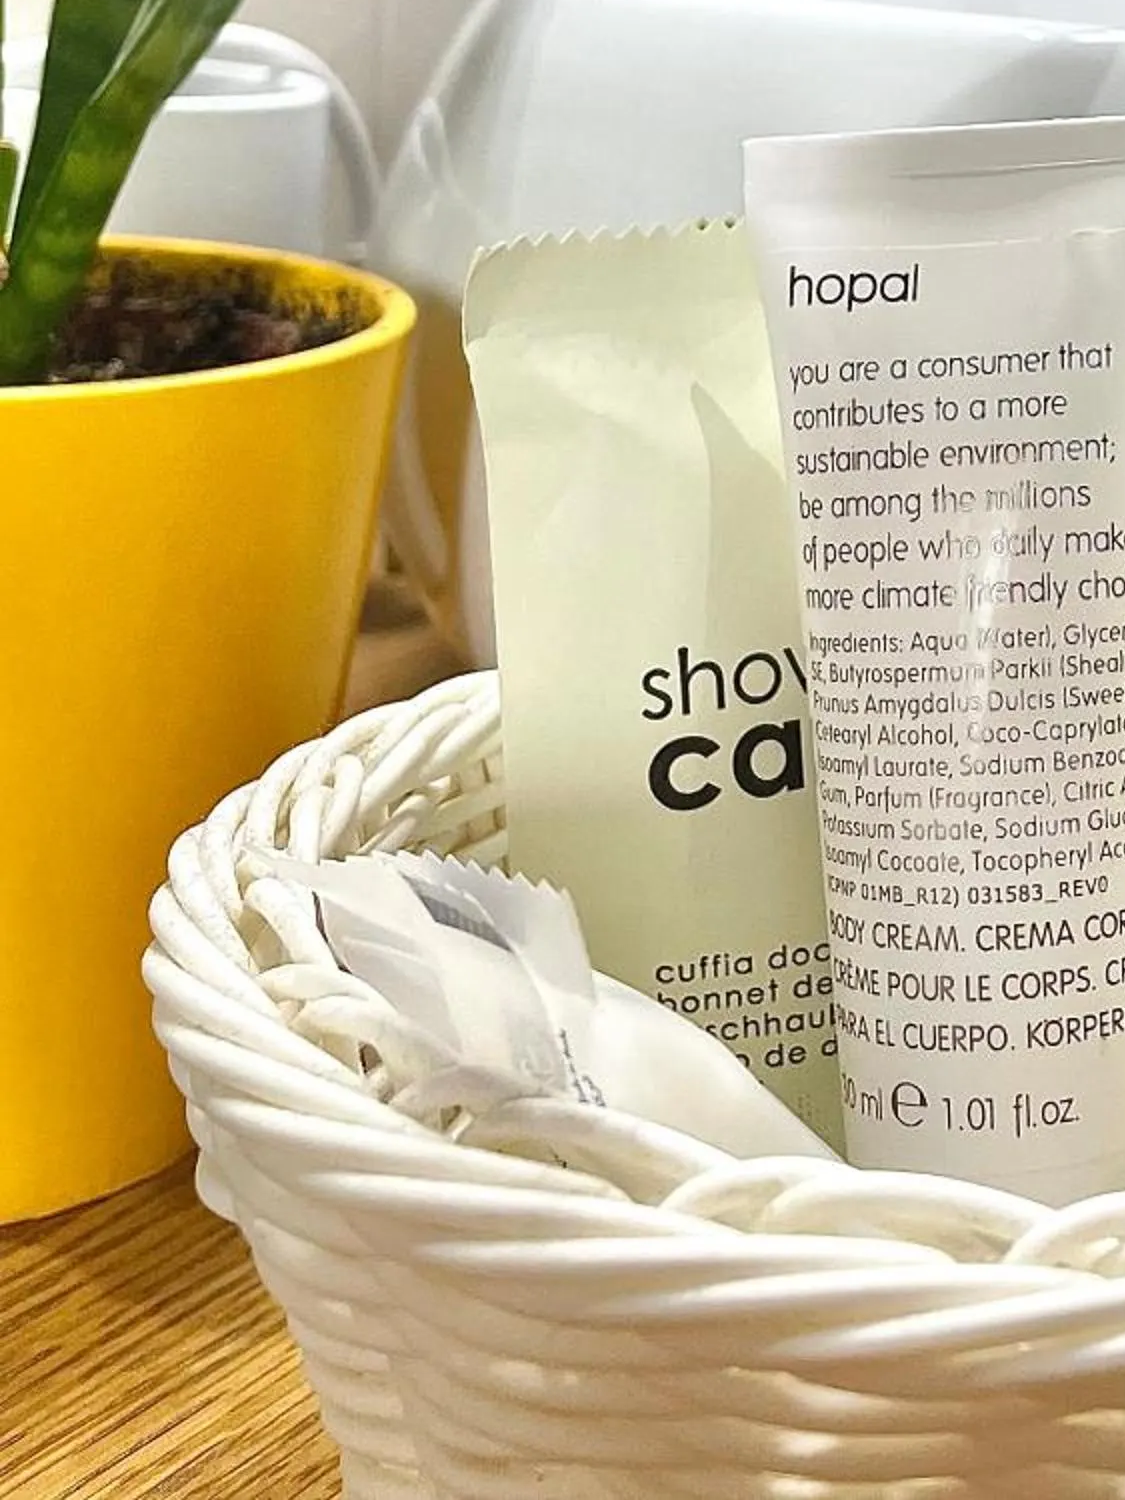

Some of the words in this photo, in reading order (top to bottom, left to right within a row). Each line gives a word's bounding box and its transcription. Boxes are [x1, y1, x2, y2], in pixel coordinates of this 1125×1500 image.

[788, 264, 920, 312] hopal
[789, 364, 828, 393] you
[839, 359, 879, 382] are
[890, 357, 907, 378] a
[918, 349, 1050, 378] consumer
[1059, 342, 1112, 370] that
[793, 398, 924, 431] contributes
[936, 397, 958, 422] to
[970, 398, 986, 419] a
[997, 393, 1067, 417] more
[797, 441, 928, 475] sustainable
[940, 433, 1116, 468] environment;
[799, 492, 823, 518] be
[831, 491, 921, 522] among
[932, 484, 976, 513] the
[985, 480, 1091, 511] millions
[803, 536, 818, 566] of
[824, 529, 908, 569] people
[919, 529, 979, 559] who
[993, 525, 1054, 561] daily
[806, 584, 852, 610] more
[863, 580, 956, 610] climate
[911, 633, 967, 655] Aqua
[829, 659, 984, 687] Butyrospermum
[992, 656, 1052, 680] Parkii
[1061, 649, 1124, 677] (Shea)
[813, 690, 858, 714] Prunus
[864, 693, 981, 720] Amygdalus
[988, 685, 1054, 711] Dulcis
[815, 721, 871, 749] Cetearyl
[877, 721, 959, 747] Alcohol,
[875, 754, 953, 779] Laurate,
[960, 752, 1044, 776] Sodium
[855, 783, 921, 813] Parfum
[929, 781, 1056, 813] (Fragrance),
[1063, 775, 1114, 802] Citric
[901, 818, 987, 842] Sorbate,
[995, 813, 1080, 839] Sodium
[877, 850, 965, 875] Cocoate,
[973, 839, 1092, 876] Tocopheryl
[830, 909, 864, 946] BODY
[872, 922, 965, 953] CREAM.
[975, 919, 1074, 951] CREMA
[656, 953, 753, 984] cuffia
[793, 974, 832, 998] de
[888, 972, 955, 1003] POUR
[966, 975, 992, 1001] LE
[1002, 966, 1096, 1001] CORPS.
[875, 1020, 895, 1047] EL
[903, 1024, 1015, 1052] CUERPO.
[765, 1043, 806, 1067] de
[861, 1086, 883, 1121] ml
[941, 1097, 995, 1131] 1.01
